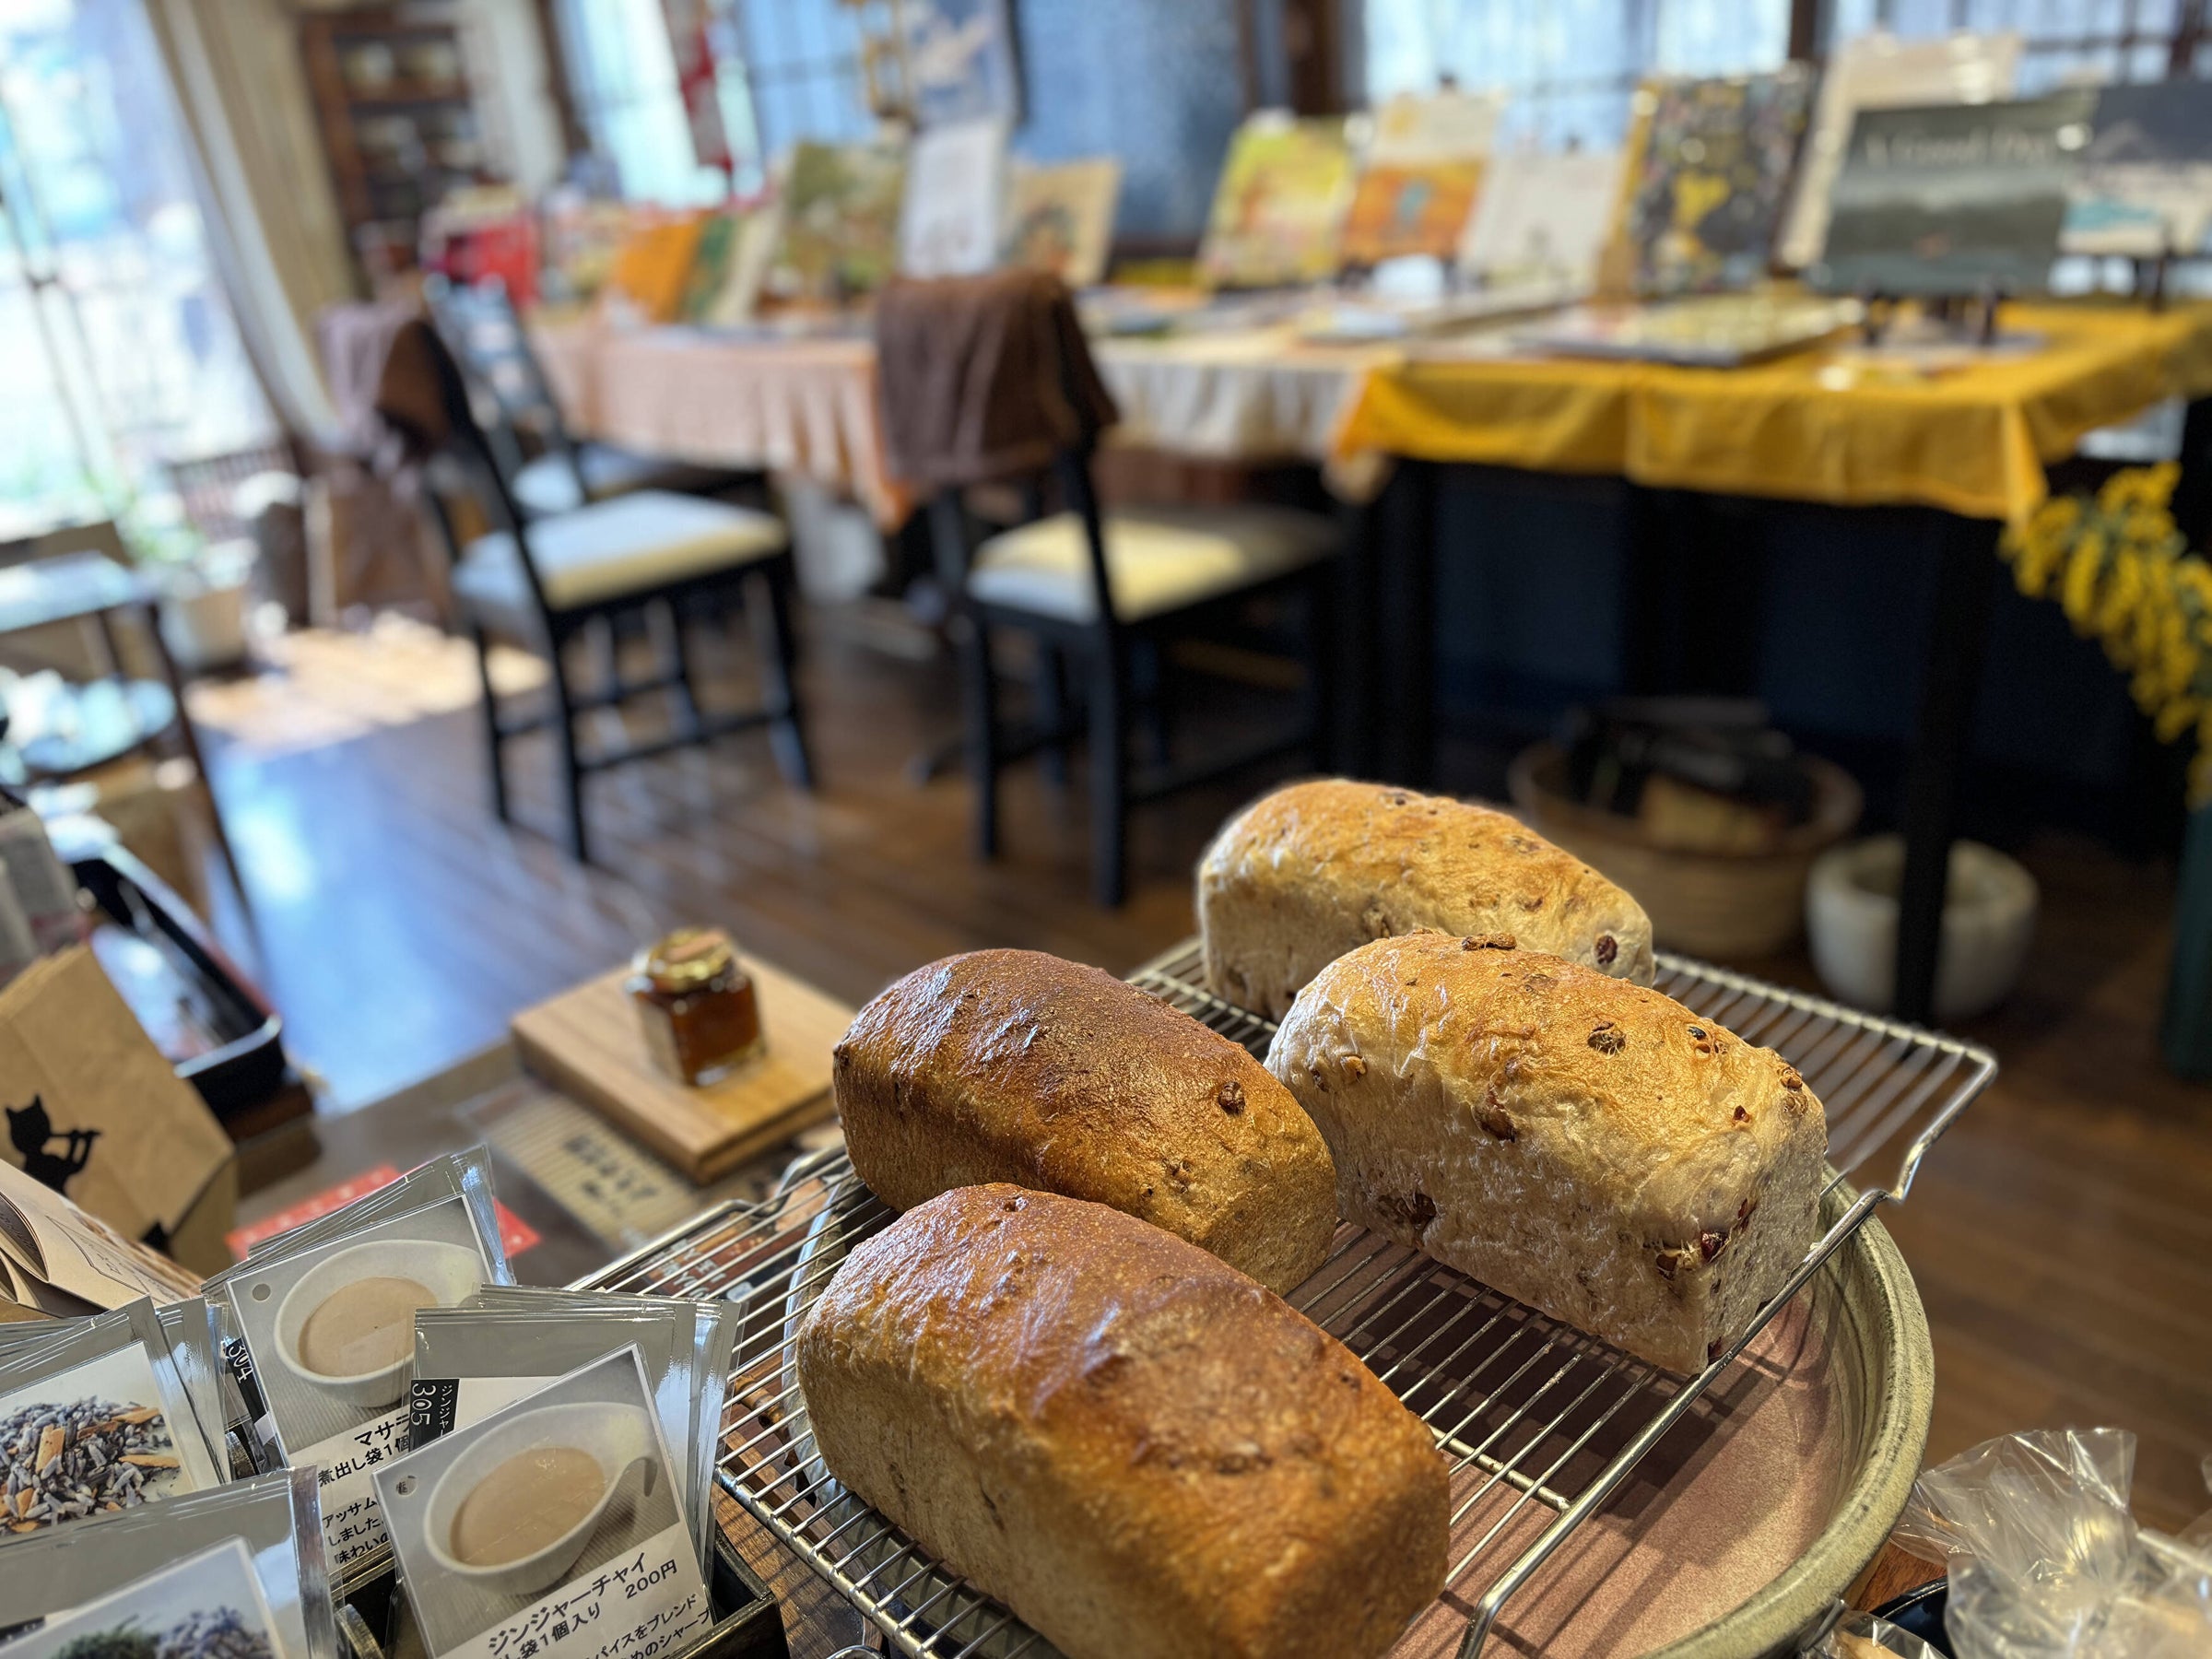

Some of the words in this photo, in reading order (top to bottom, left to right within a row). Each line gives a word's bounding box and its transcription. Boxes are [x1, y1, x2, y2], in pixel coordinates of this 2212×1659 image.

[411, 1382, 437, 1426] 305
[354, 1413, 410, 1446] マサラ
[322, 1496, 378, 1529] アッサム
[624, 1558, 678, 1600] 200円
[488, 1551, 645, 1656] ジンジャーチャイ
[585, 1593, 697, 1659] パイスをブレンド
[621, 1606, 711, 1659] めのシャープ
